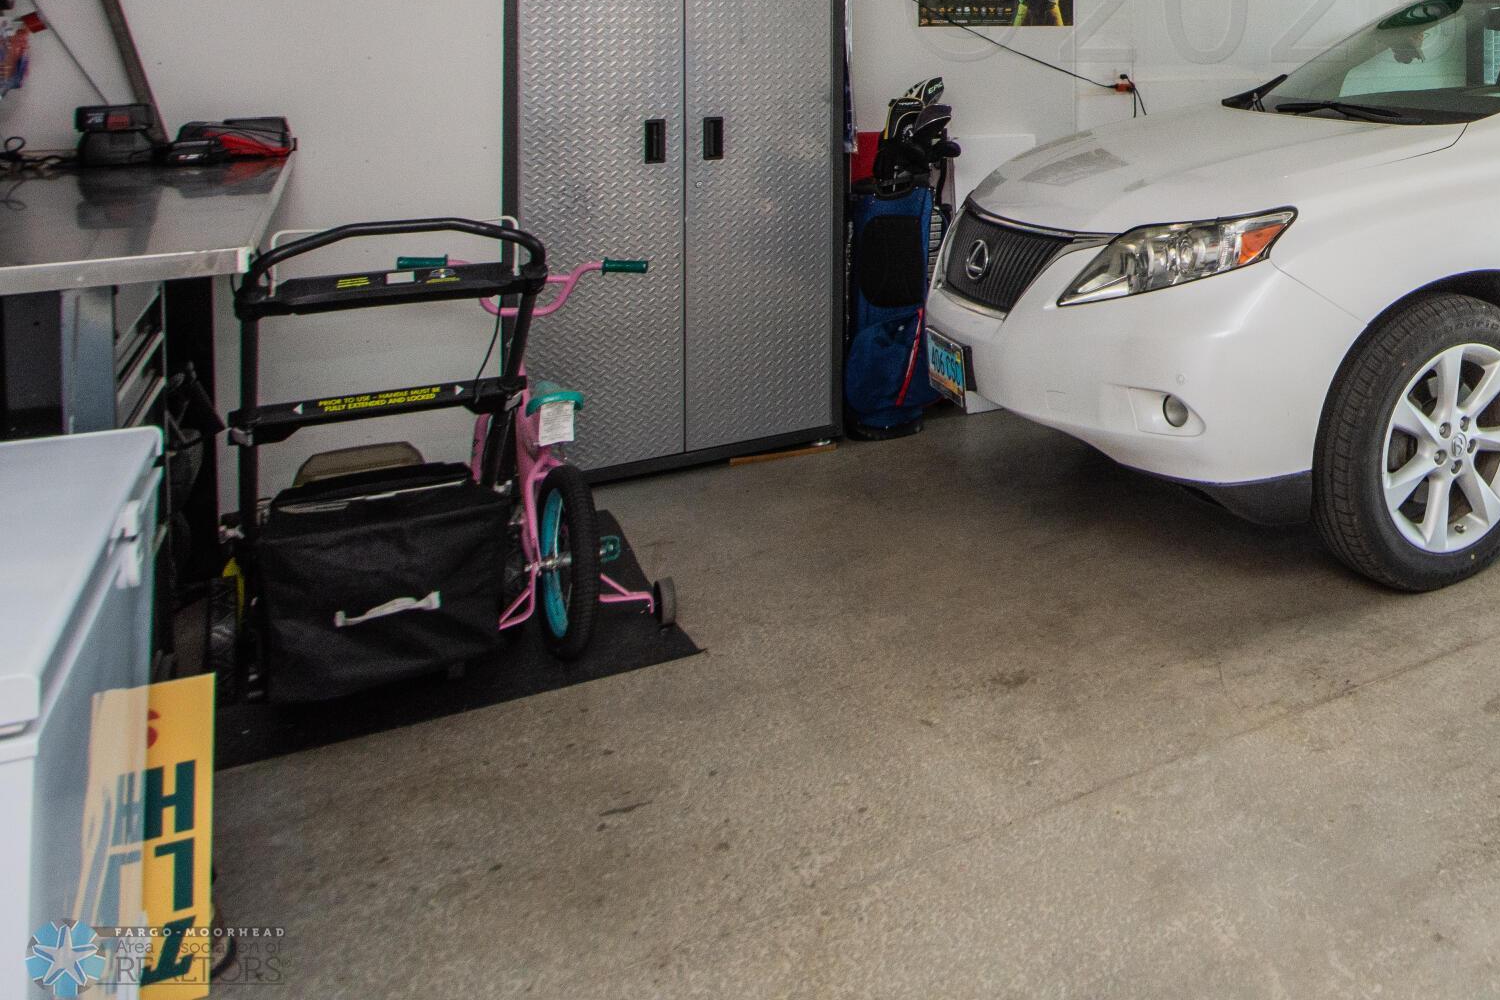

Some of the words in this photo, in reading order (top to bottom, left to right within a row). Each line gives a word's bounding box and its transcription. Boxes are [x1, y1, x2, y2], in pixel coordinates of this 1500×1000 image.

[318, 397, 340, 406] PRIOR
[343, 396, 355, 404] TO
[356, 394, 371, 402] USE
[379, 390, 408, 399] HANDLE
[410, 388, 430, 396] MUST
[324, 403, 346, 412] FULLY
[348, 400, 386, 410] EXTENDED
[388, 397, 406, 406] AND
[407, 393, 436, 403] LOCKED
